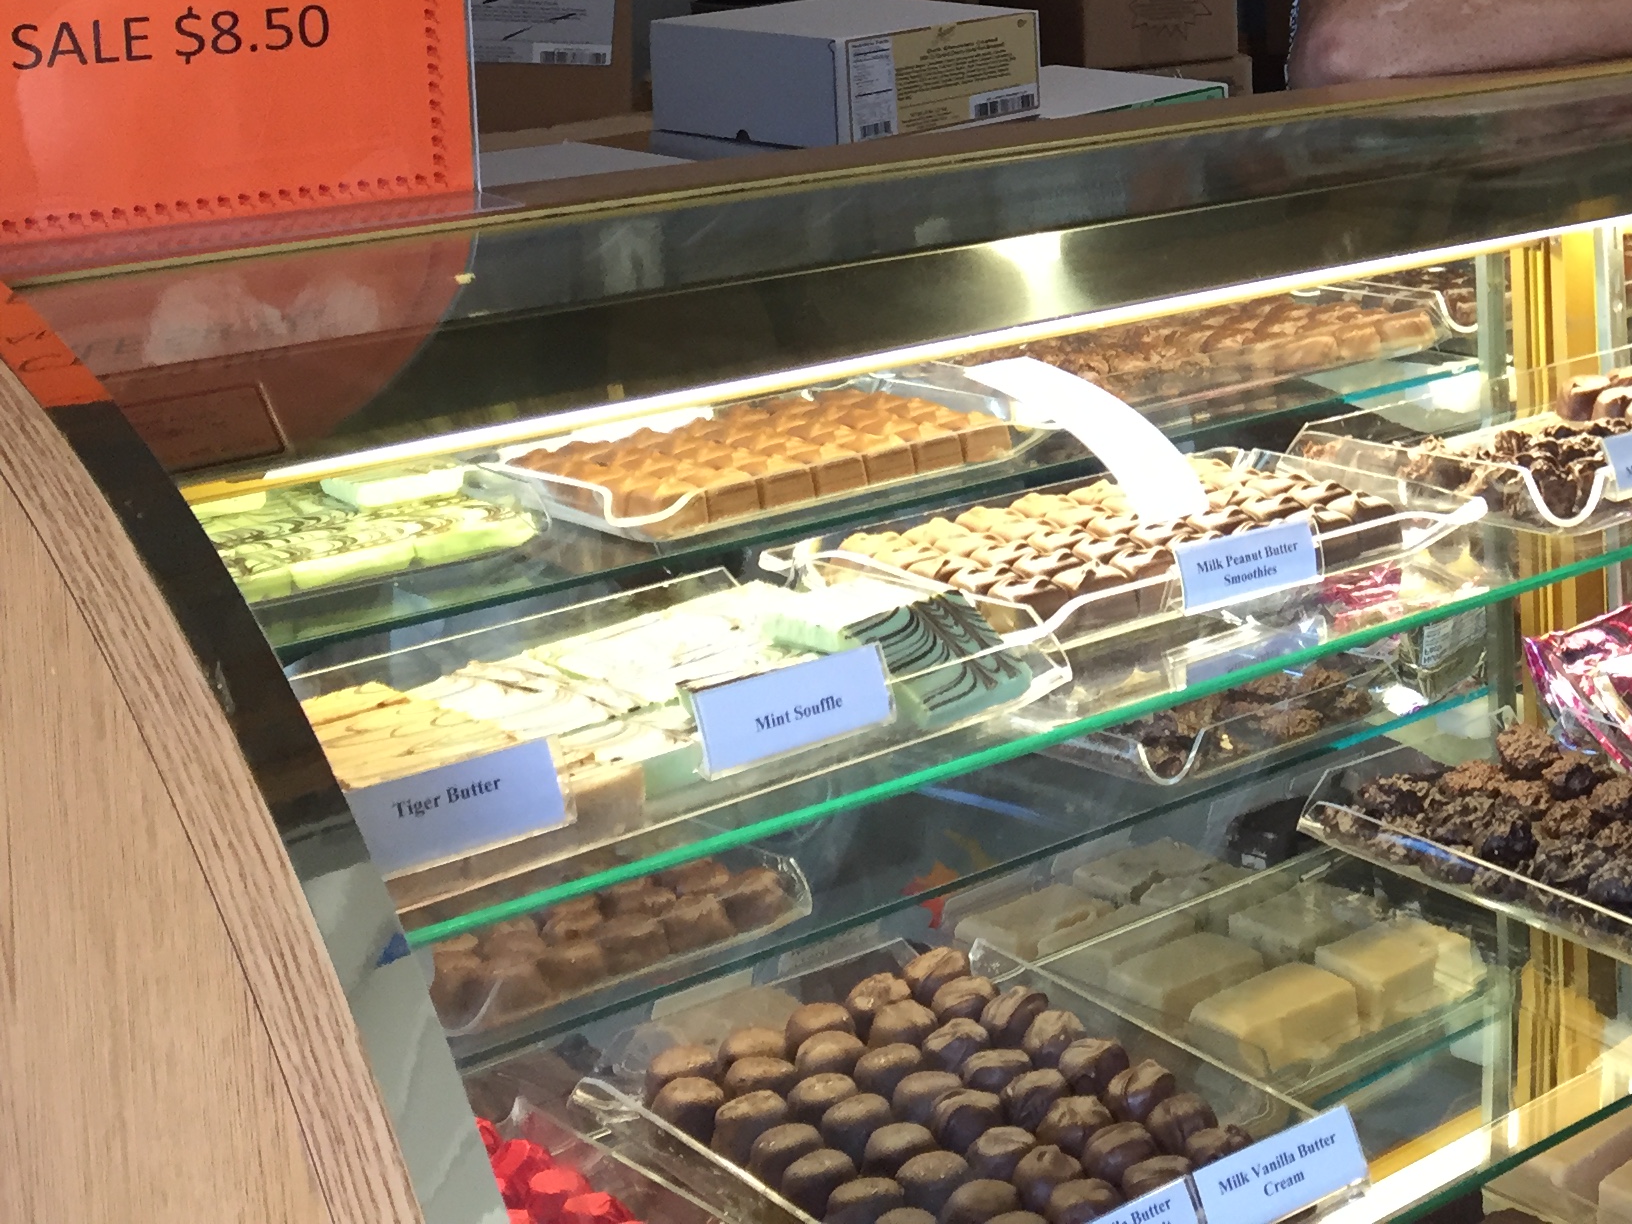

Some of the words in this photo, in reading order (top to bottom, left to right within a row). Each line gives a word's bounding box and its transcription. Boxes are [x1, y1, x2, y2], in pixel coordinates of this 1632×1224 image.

[11, 15, 153, 71] SALE
[175, 5, 330, 66] $8.50
[1196, 558, 1224, 575] Milk
[1225, 548, 1263, 568] Peanut
[1264, 541, 1299, 558] Butter
[1223, 564, 1278, 587] Smoothies
[754, 710, 793, 735] Mint
[794, 694, 843, 721] Souffle
[391, 795, 441, 819] Tiger
[446, 776, 502, 805] Butter
[1218, 1172, 1250, 1196] Milk
[1250, 1152, 1296, 1178] Vanilla
[1297, 1131, 1337, 1159] Butter
[1262, 1169, 1306, 1198] Cream
[1130, 1196, 1172, 1224] Butter
